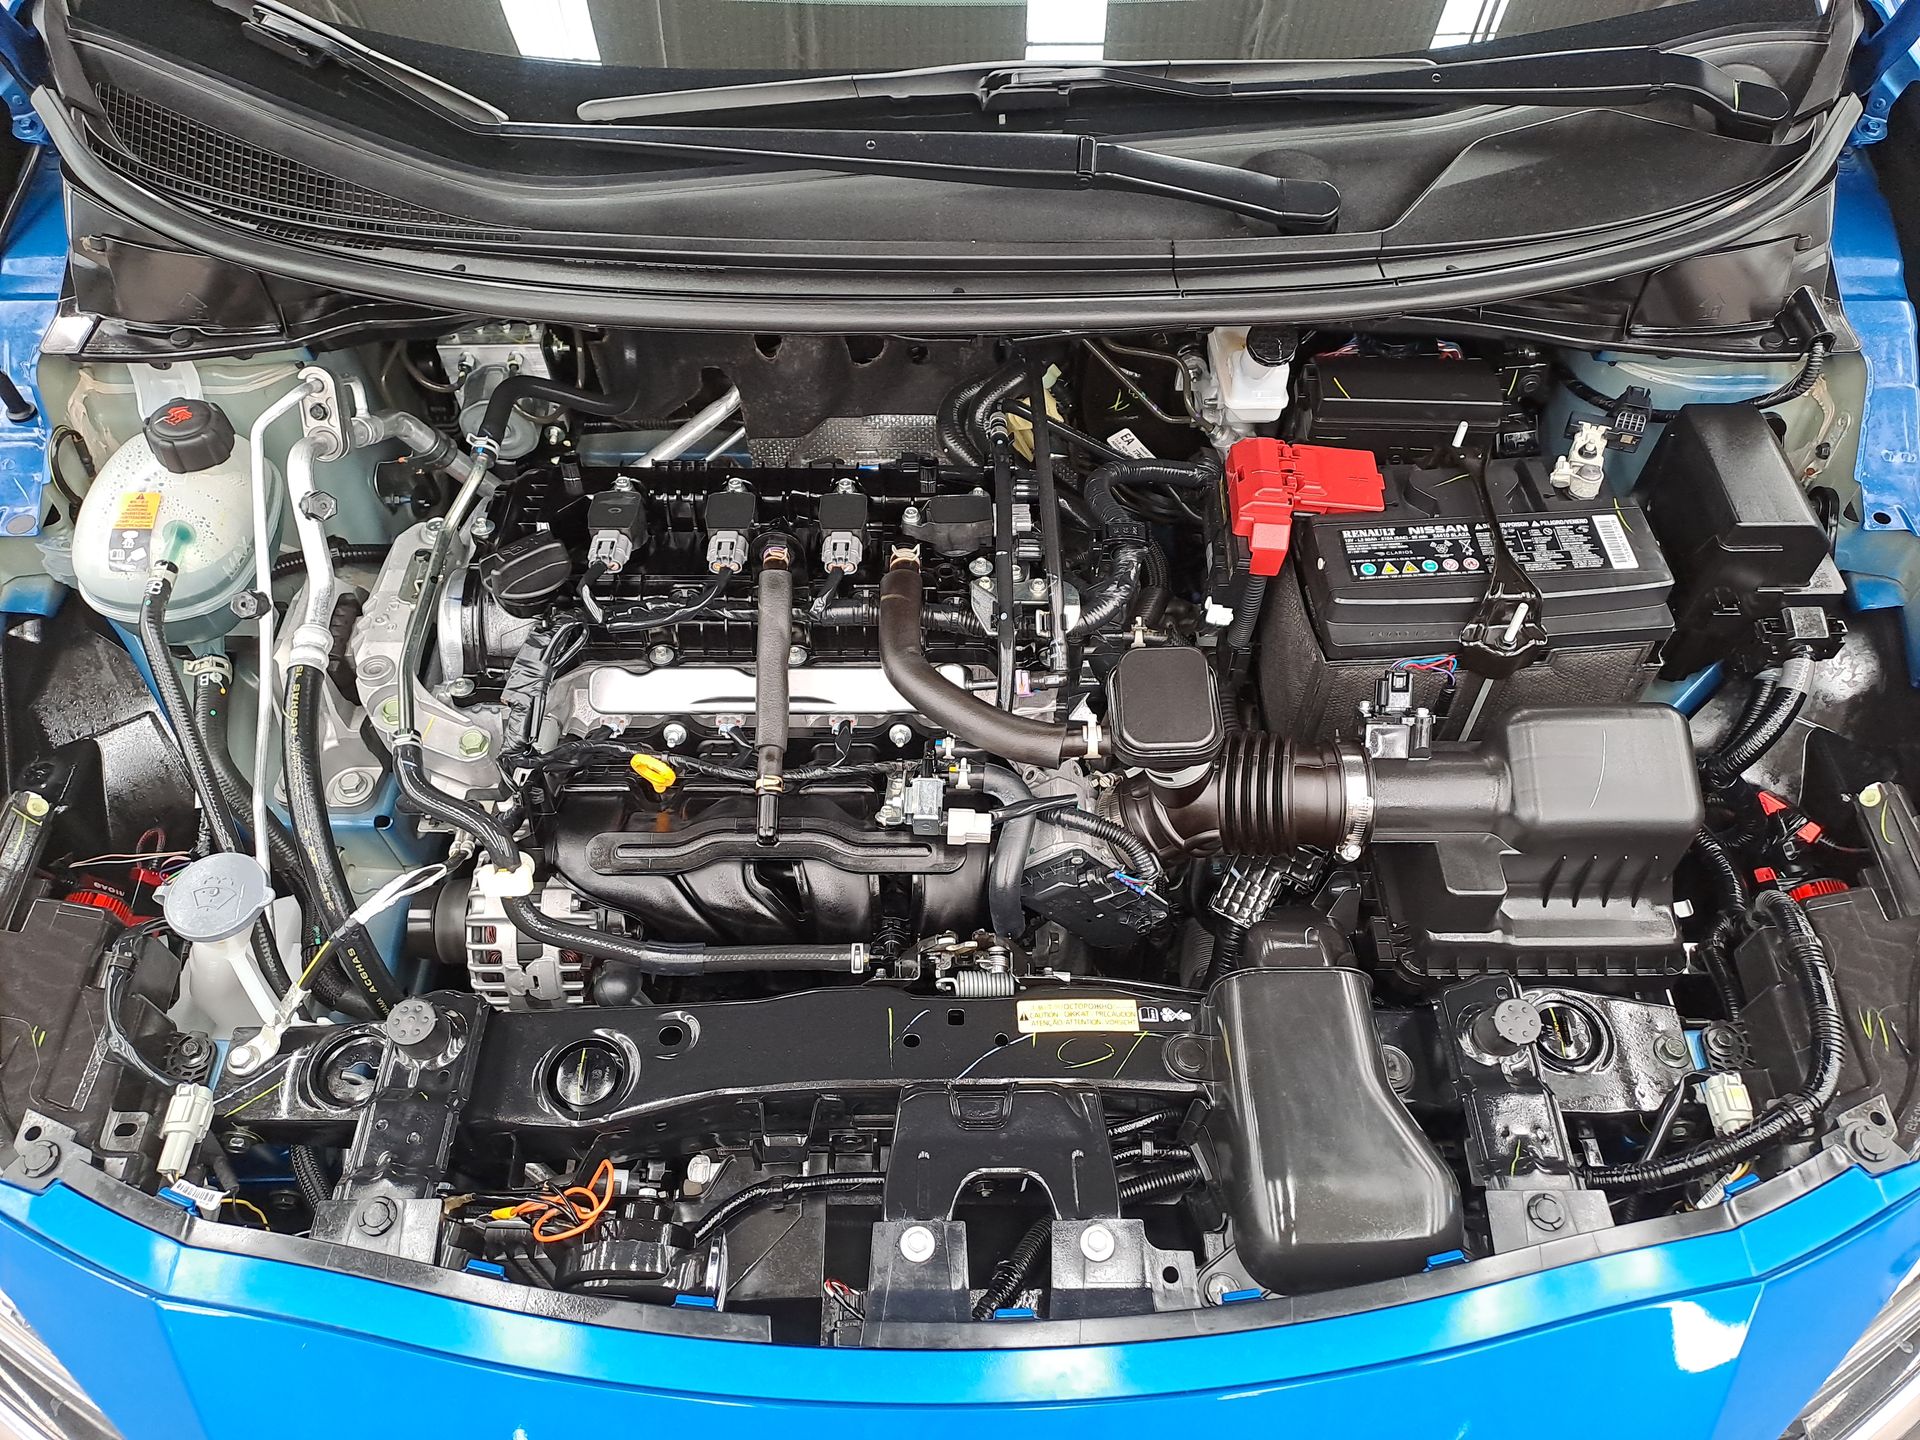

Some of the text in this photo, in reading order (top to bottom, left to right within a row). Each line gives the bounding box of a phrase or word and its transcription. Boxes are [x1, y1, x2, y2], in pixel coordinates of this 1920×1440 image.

[1120, 433, 1135, 446] EA
[1342, 524, 1469, 538] RENAULT NISSAN
[1065, 1018, 1102, 1026] ATTENTION
